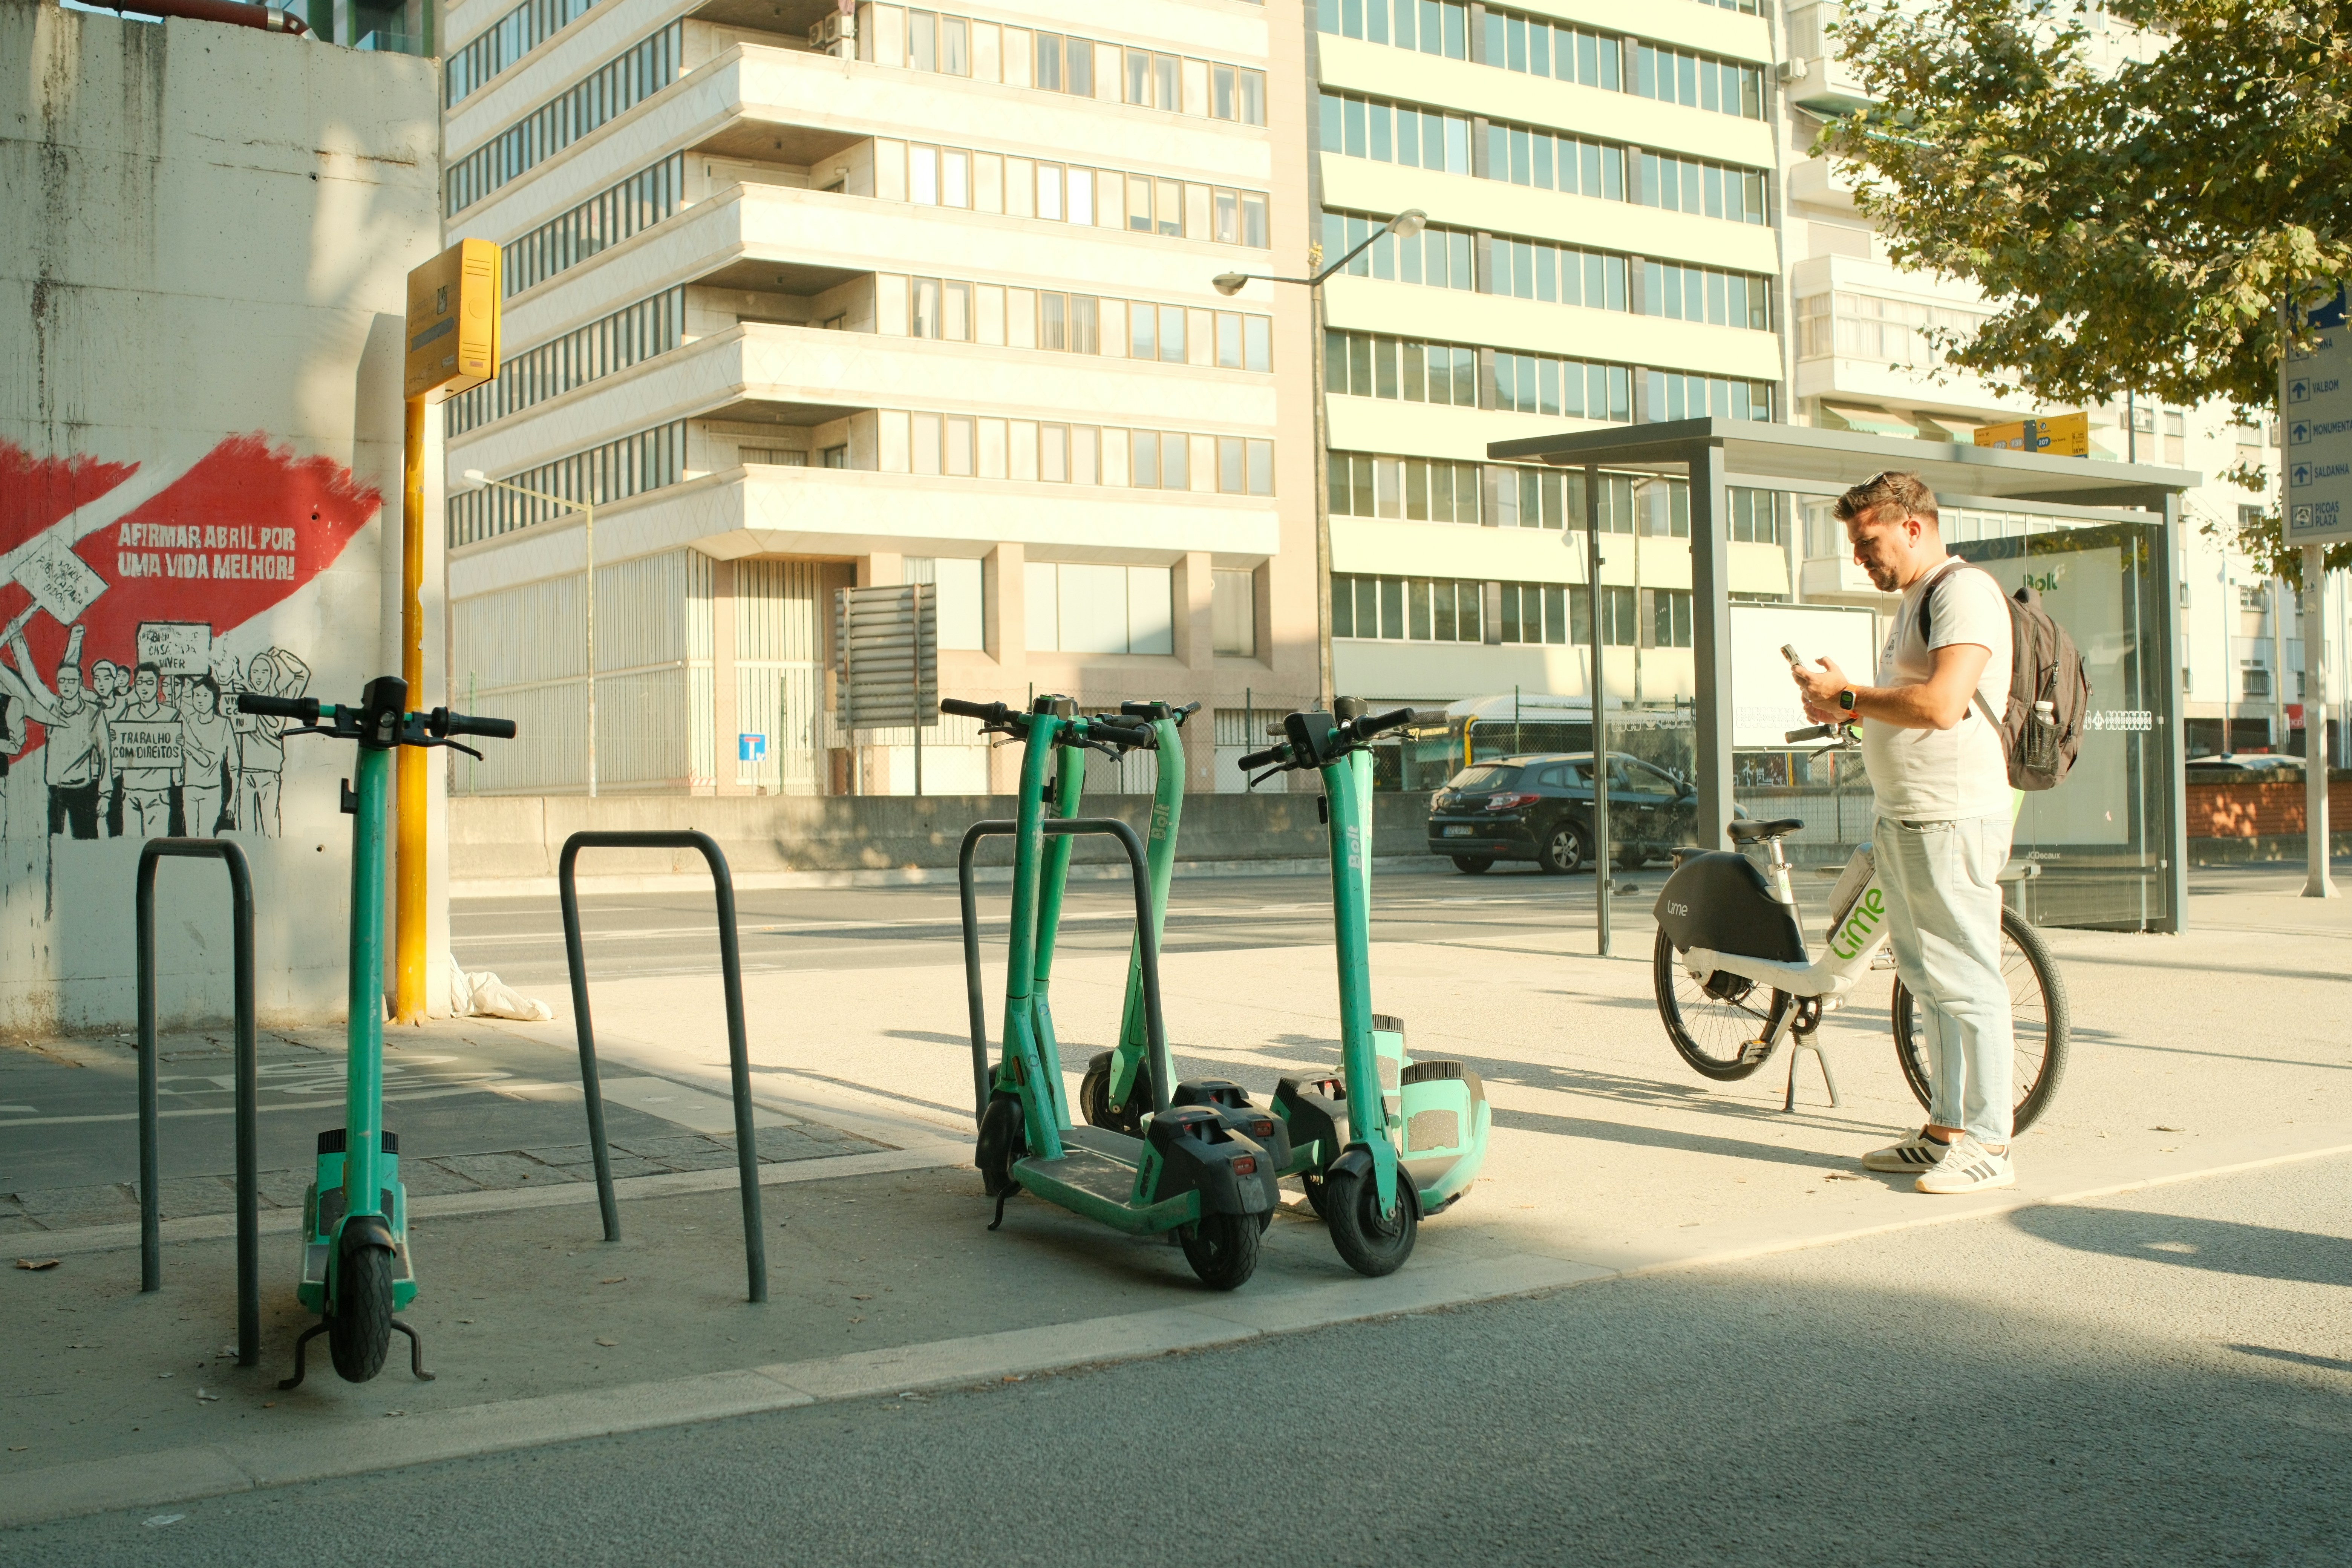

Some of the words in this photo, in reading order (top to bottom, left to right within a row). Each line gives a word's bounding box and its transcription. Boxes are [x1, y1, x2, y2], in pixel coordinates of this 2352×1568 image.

[2312, 379, 2339, 393] VALBOM
[2314, 464, 2349, 478] SALDANHA
[2315, 501, 2339, 514] PICOAS
[2316, 514, 2337, 527] PLAZA
[118, 523, 201, 549] AFIRMAR
[204, 525, 256, 550] ABRIL
[260, 527, 296, 551] POR
[118, 552, 162, 577] UMA
[165, 553, 209, 579] VIDA
[213, 554, 295, 580] MELHOR!
[2023, 573, 2058, 597] Bolt
[121, 732, 171, 745] TRABALHO
[113, 746, 135, 758] COM
[136, 746, 179, 758] DIREITOS
[1151, 804, 1170, 840] Bolt
[1347, 825, 1362, 869] Bolt
[2026, 851, 2060, 859] JCDecaux
[1668, 900, 1688, 917] Lime
[1830, 888, 1885, 959] Lime
